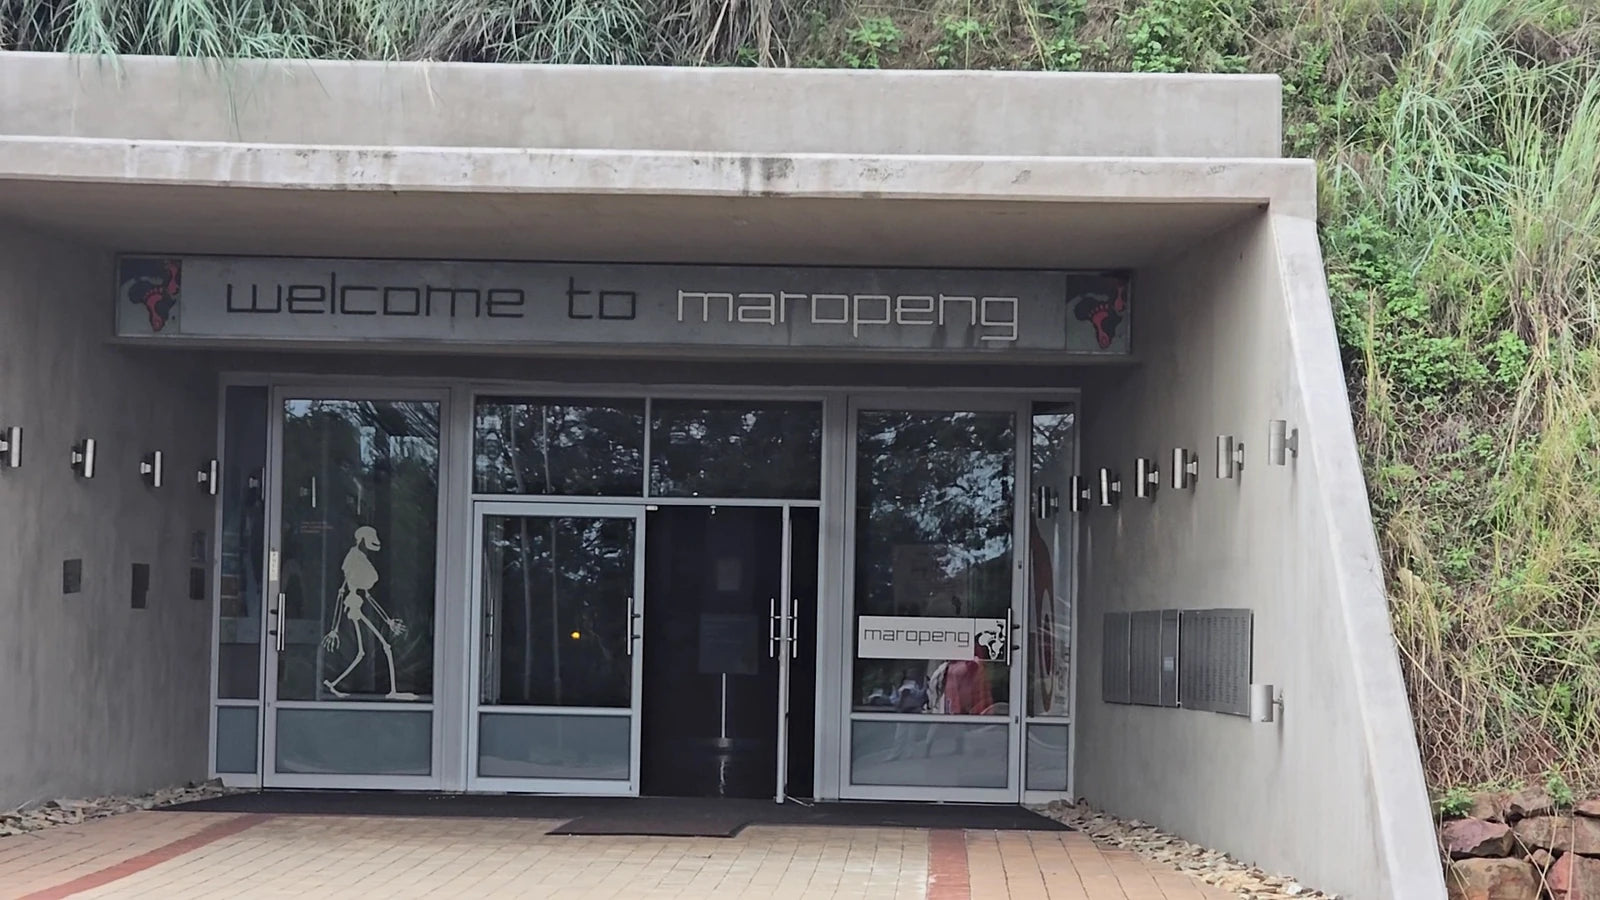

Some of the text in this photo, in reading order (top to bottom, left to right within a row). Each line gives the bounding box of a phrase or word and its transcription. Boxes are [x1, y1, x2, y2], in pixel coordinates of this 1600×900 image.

[227, 271, 1019, 341] welcome to maropeng
[864, 629, 970, 648] maropeng
